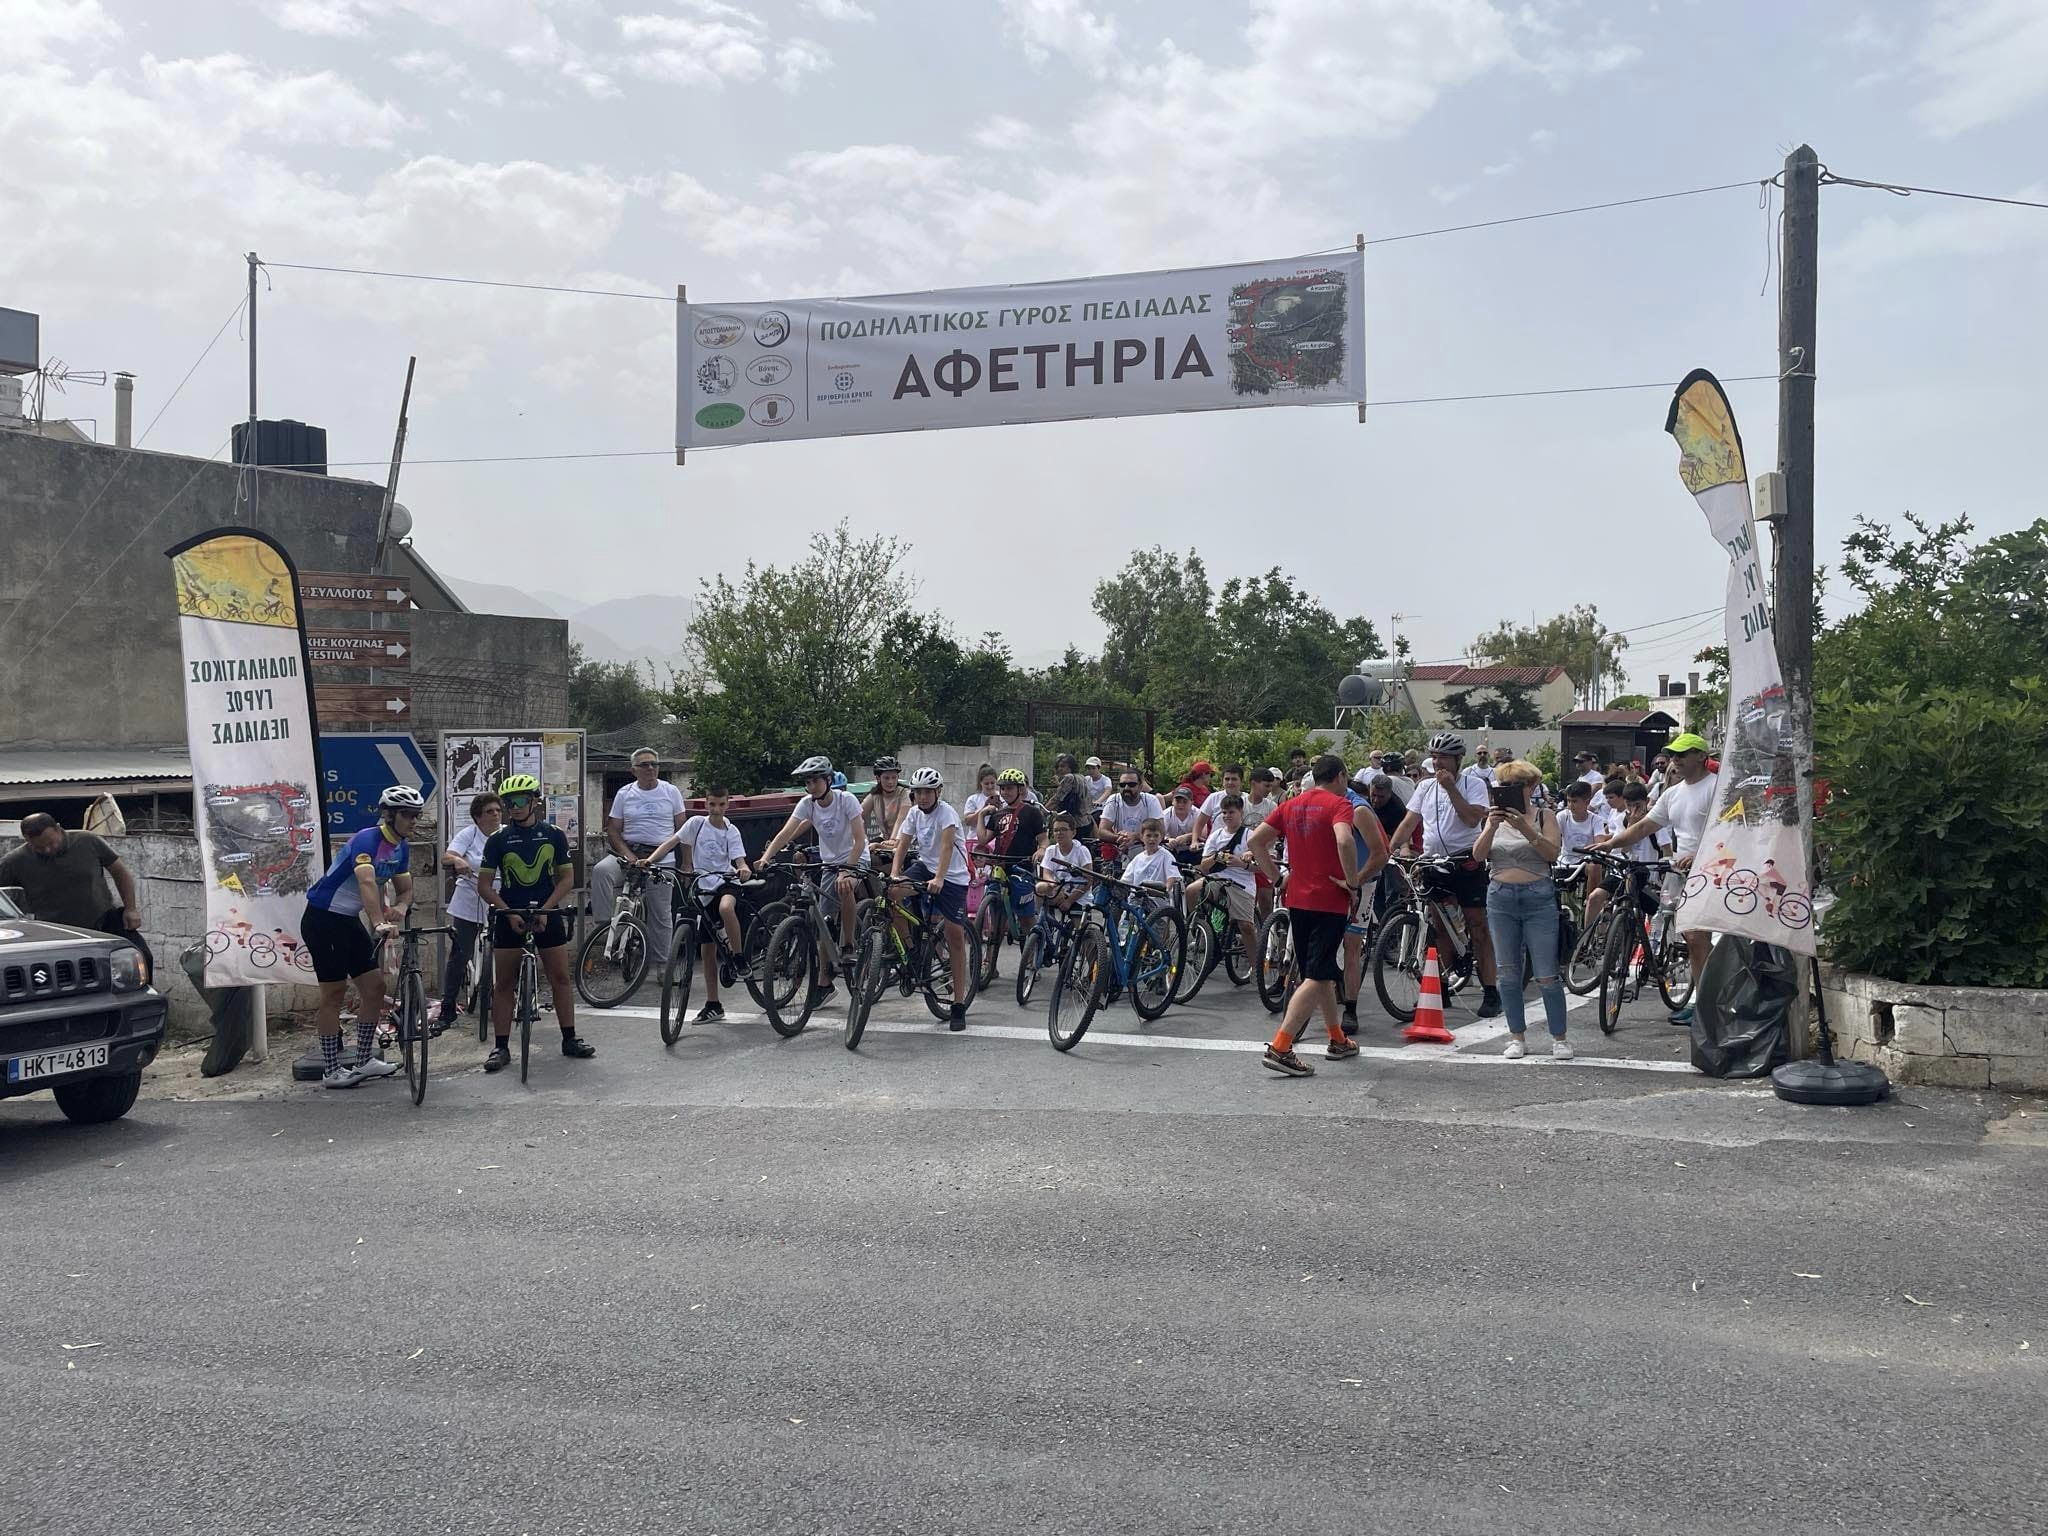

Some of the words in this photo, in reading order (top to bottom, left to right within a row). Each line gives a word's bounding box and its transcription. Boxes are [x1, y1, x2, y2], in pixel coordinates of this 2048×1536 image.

[821, 311, 989, 341] ΠΟΔΗΛΑΤΙΚΟΣ
[999, 305, 1072, 327] ΓΥΡΟΣ
[1083, 294, 1211, 321] ΠΕΔΙΑΔΑΣ
[893, 334, 1214, 400] ΑΦΕΤΗΡΙΑ
[816, 393, 850, 401] ΠΕΡΙΦΕΡΕΙΑ
[310, 586, 373, 600] ΣΥΛΛΟΓΟΣ
[330, 638, 384, 649] ΚΟΥΖΙΝΑΣ
[308, 650, 356, 660] FESTIVAL
[25, 1048, 106, 1077] HKT-4813
